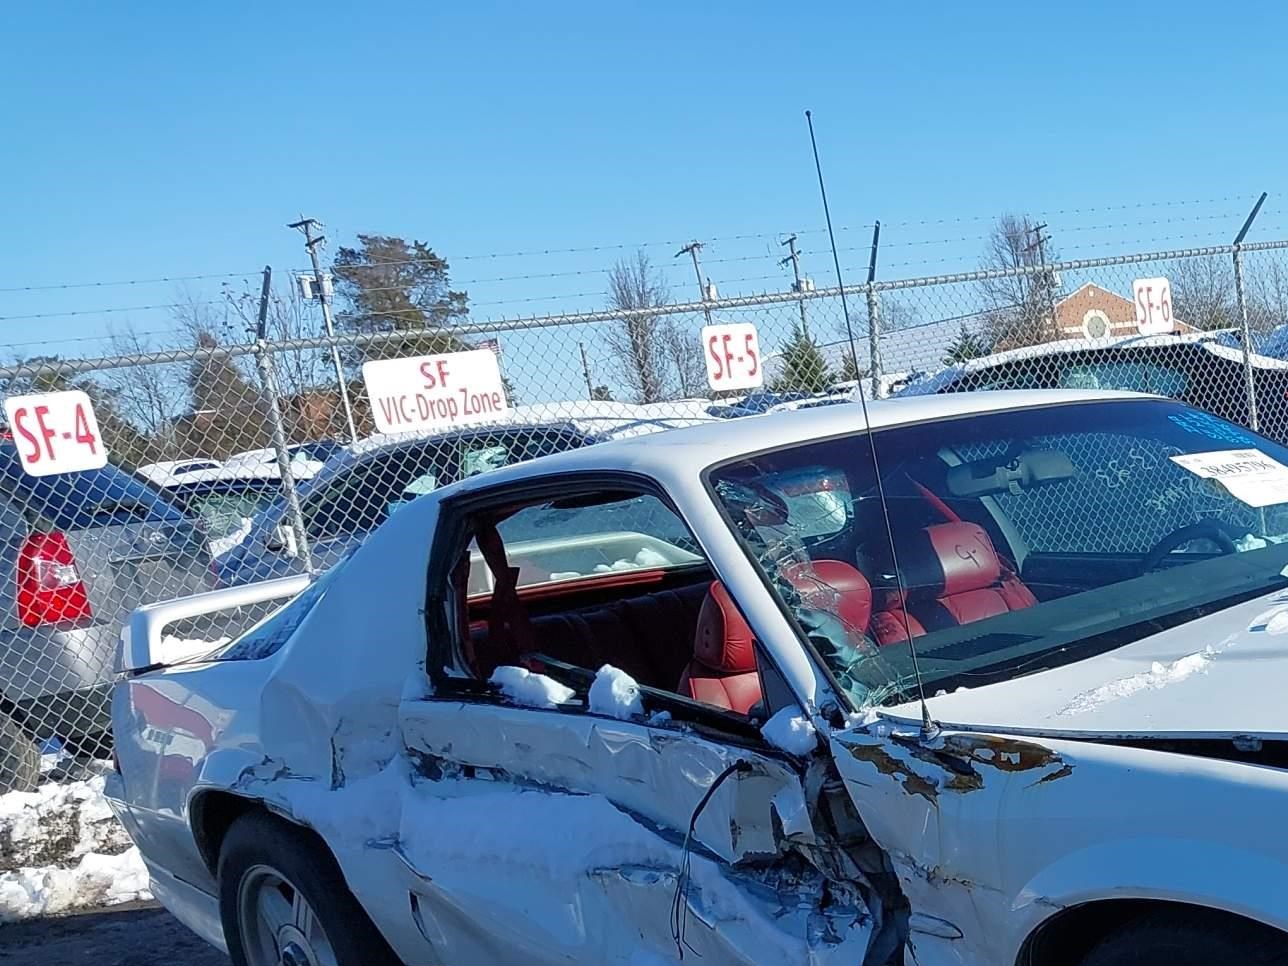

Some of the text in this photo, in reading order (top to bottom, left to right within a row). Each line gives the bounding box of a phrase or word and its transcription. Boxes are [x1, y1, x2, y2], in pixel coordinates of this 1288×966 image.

[1137, 286, 1170, 324] SF-6
[420, 360, 450, 390] SF
[708, 334, 757, 380] SF-5
[378, 387, 503, 426] VIC-Drop Zone
[14, 403, 97, 464] SF-4
